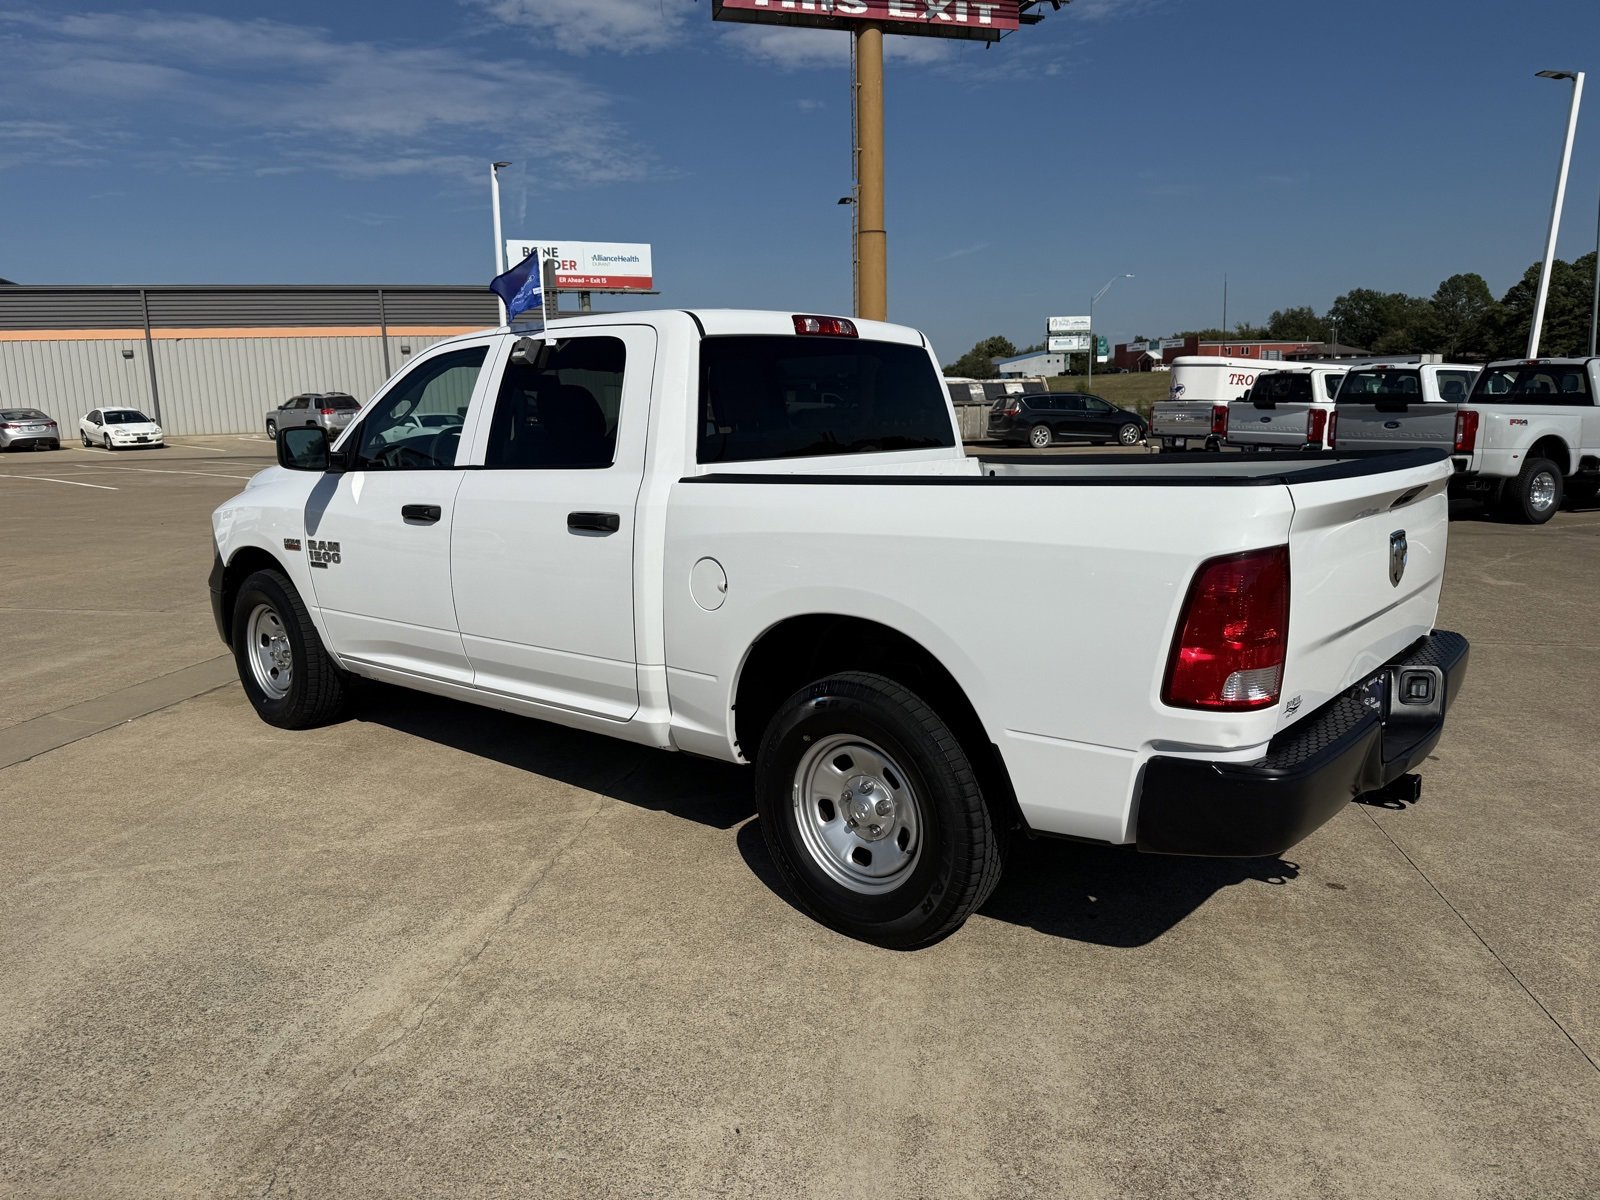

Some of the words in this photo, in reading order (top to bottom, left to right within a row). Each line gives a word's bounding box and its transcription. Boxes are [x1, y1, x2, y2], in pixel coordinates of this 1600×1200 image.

[754, 0, 869, 14] IS
[888, 0, 1000, 24] EXIT
[1229, 373, 1256, 386] TRO
[308, 540, 340, 553] RAM
